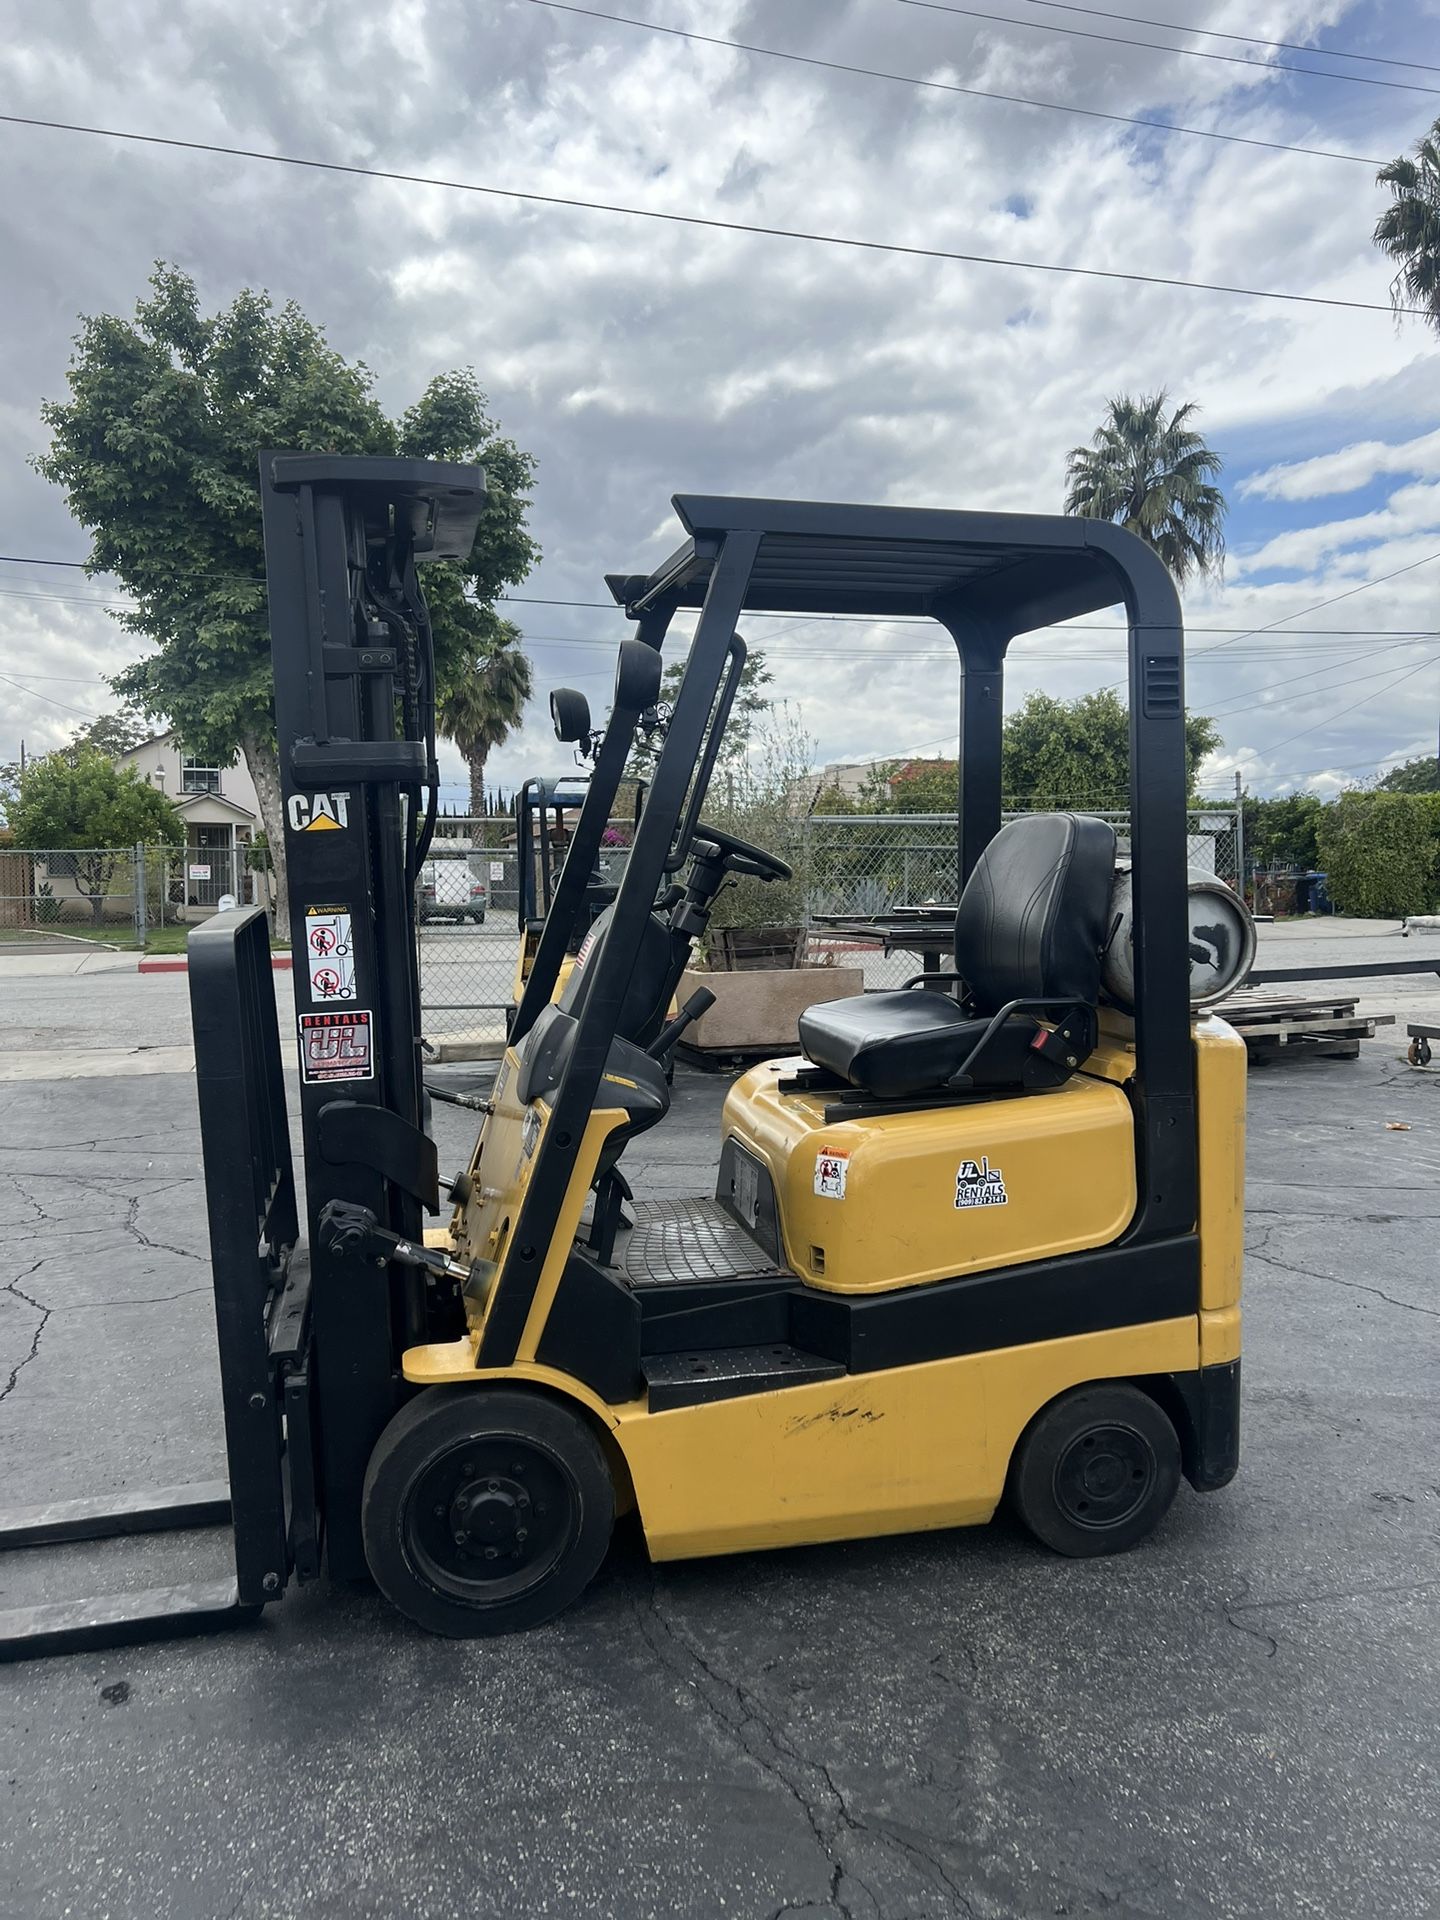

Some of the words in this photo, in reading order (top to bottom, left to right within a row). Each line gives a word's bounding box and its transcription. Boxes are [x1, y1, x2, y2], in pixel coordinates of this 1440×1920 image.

[287, 792, 351, 831] CAT
[317, 906, 347, 914] WARNING
[304, 1013, 369, 1027] RENTALS
[957, 1184, 1004, 1200] RENTALS
